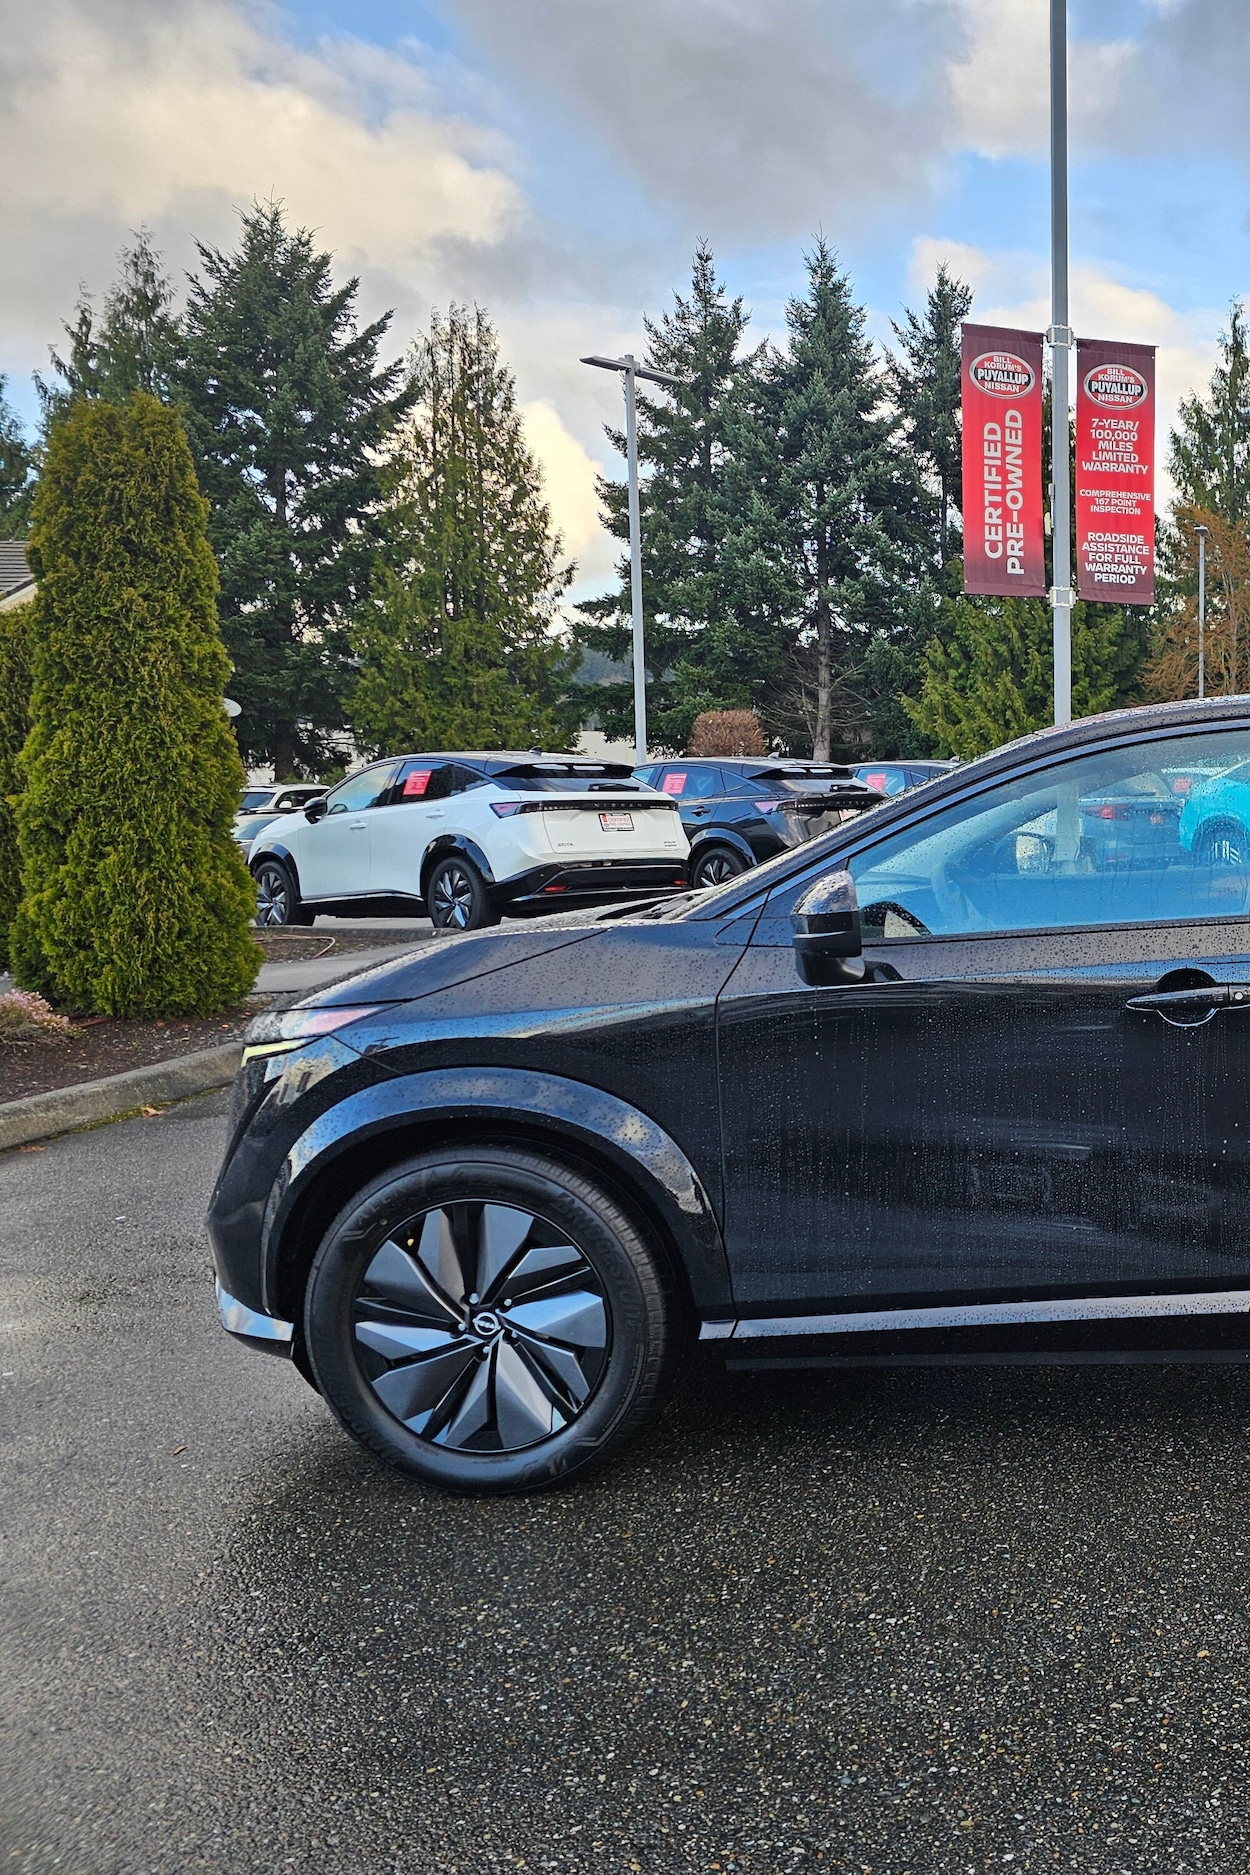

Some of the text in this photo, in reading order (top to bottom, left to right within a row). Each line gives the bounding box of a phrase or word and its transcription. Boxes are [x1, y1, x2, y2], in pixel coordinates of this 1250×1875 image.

[993, 355, 1012, 364] BILL
[975, 361, 1022, 372] KORUM'S
[1107, 368, 1125, 376] BILL
[977, 368, 1029, 385] PUYALLUP
[1098, 373, 1135, 383] KORUM'S
[984, 381, 1020, 393] NISSAN
[1091, 380, 1142, 396] PUYALLUP
[1098, 394, 1133, 403] NISSAN
[1091, 418, 1139, 431] 7-YEAR/
[1090, 429, 1138, 441] 100,000
[1098, 440, 1133, 452] MILES
[1092, 451, 1139, 463] LIMITED
[1082, 461, 1149, 475] WARRANTY
[983, 422, 1003, 559] CERTIFIED
[1005, 409, 1025, 575] PRE-OWNED
[1080, 489, 1151, 501] COMPREHENSIVE
[1111, 499, 1137, 507] POINT
[1090, 505, 1141, 515] INSPECTION
[1087, 532, 1144, 544] ROADSIDE
[1082, 542, 1150, 555] ASSISTANCE
[1088, 552, 1141, 564] FOR FULL
[1083, 562, 1147, 575] WARRANTY
[1094, 573, 1136, 584] PERIOD
